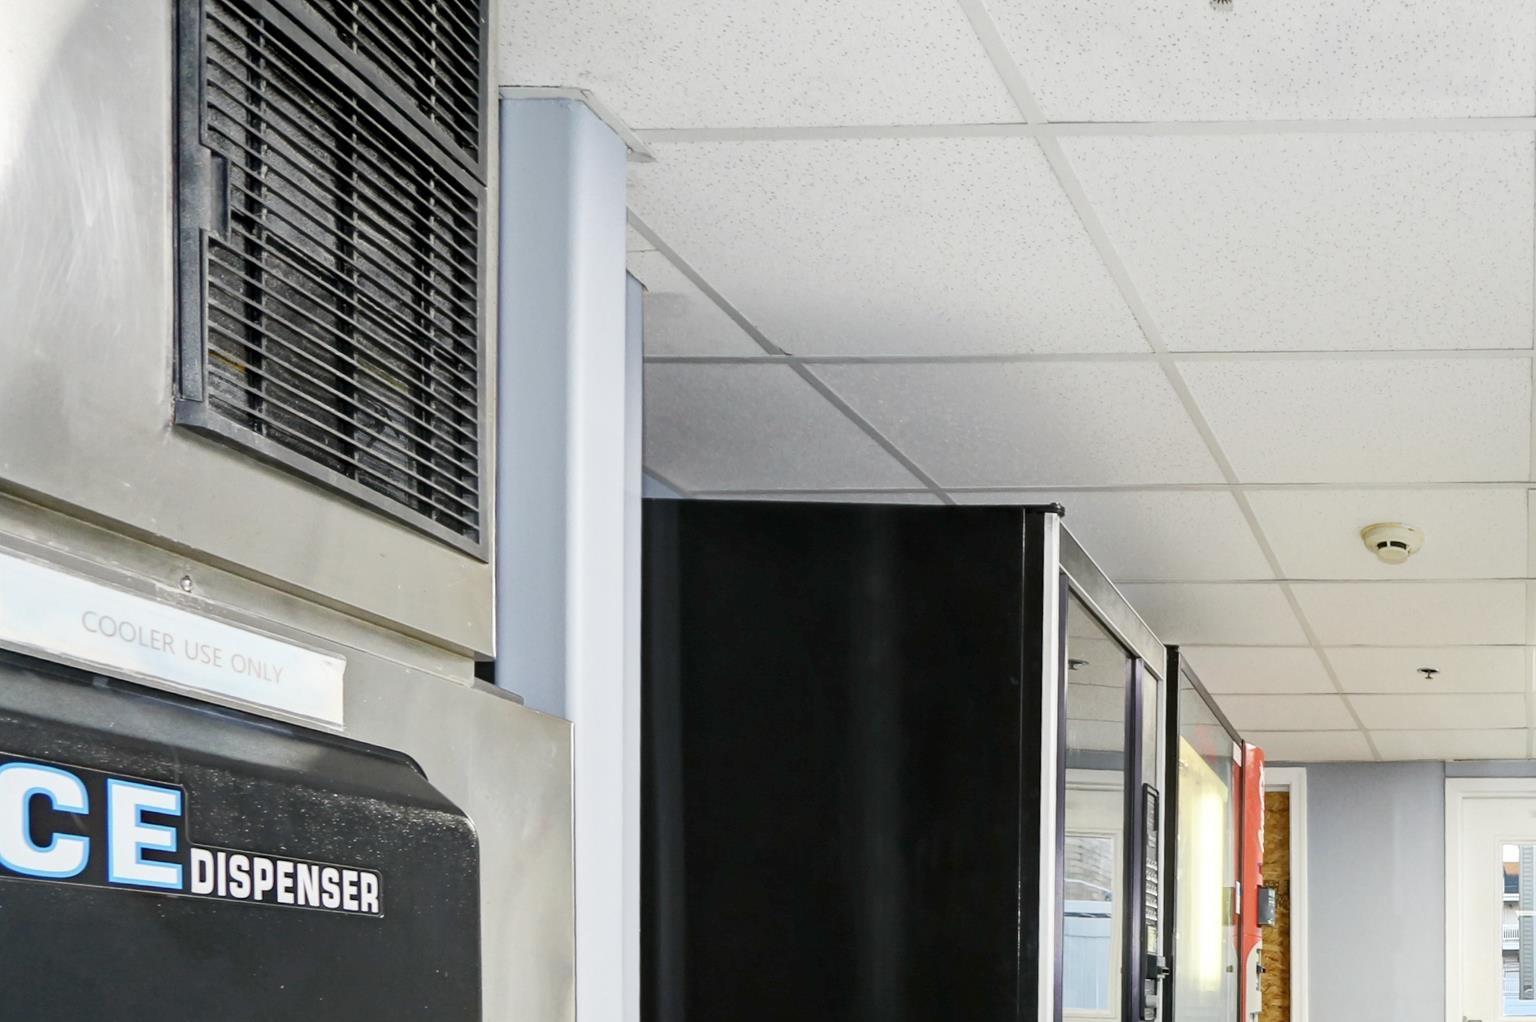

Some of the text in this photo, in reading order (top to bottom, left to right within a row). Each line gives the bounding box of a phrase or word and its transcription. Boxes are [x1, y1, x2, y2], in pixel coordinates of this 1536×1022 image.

[81, 610, 285, 685] COOLER USE ONLY
[190, 847, 380, 914] DISPENSER
